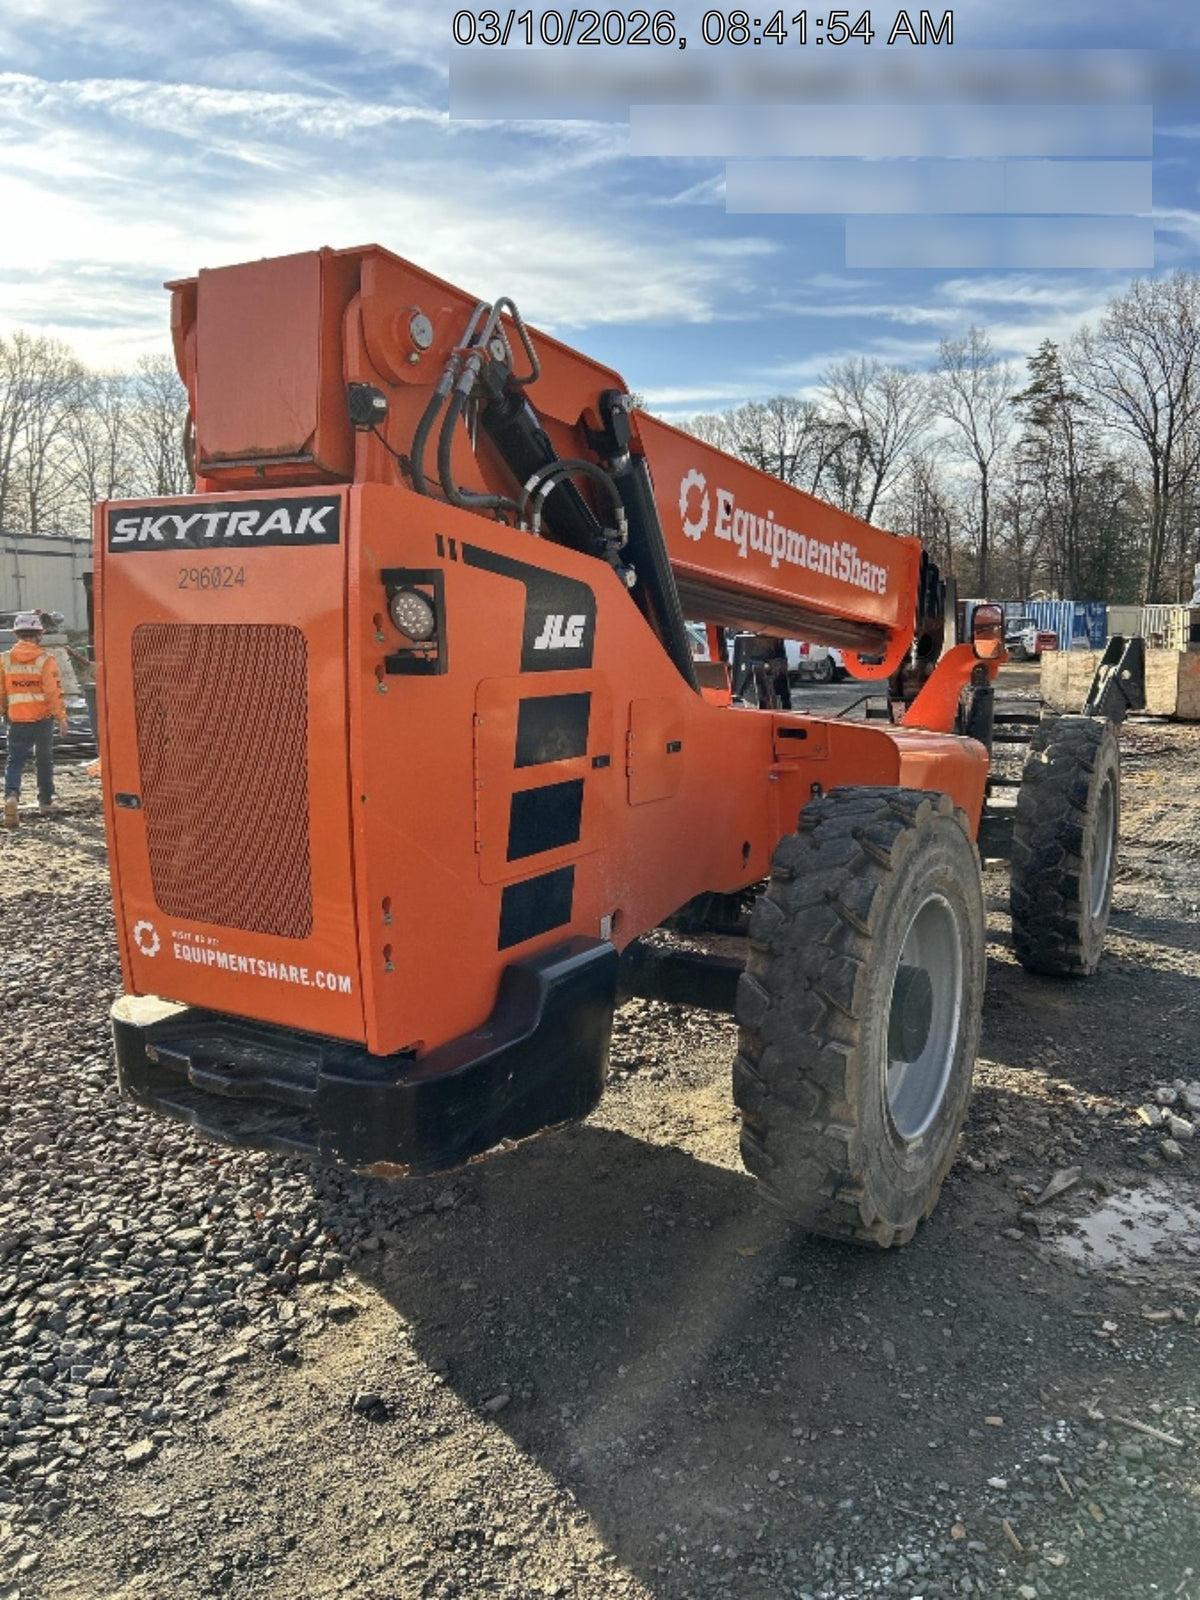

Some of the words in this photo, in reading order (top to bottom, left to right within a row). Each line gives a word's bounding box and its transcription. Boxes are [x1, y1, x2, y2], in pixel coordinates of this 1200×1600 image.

[111, 506, 335, 543] SKYTRAK
[714, 488, 887, 595] EquipmentShare
[178, 566, 247, 590] 296024
[533, 614, 587, 649] JLG
[173, 943, 352, 994] EQUIPMENTSHARE.COM
